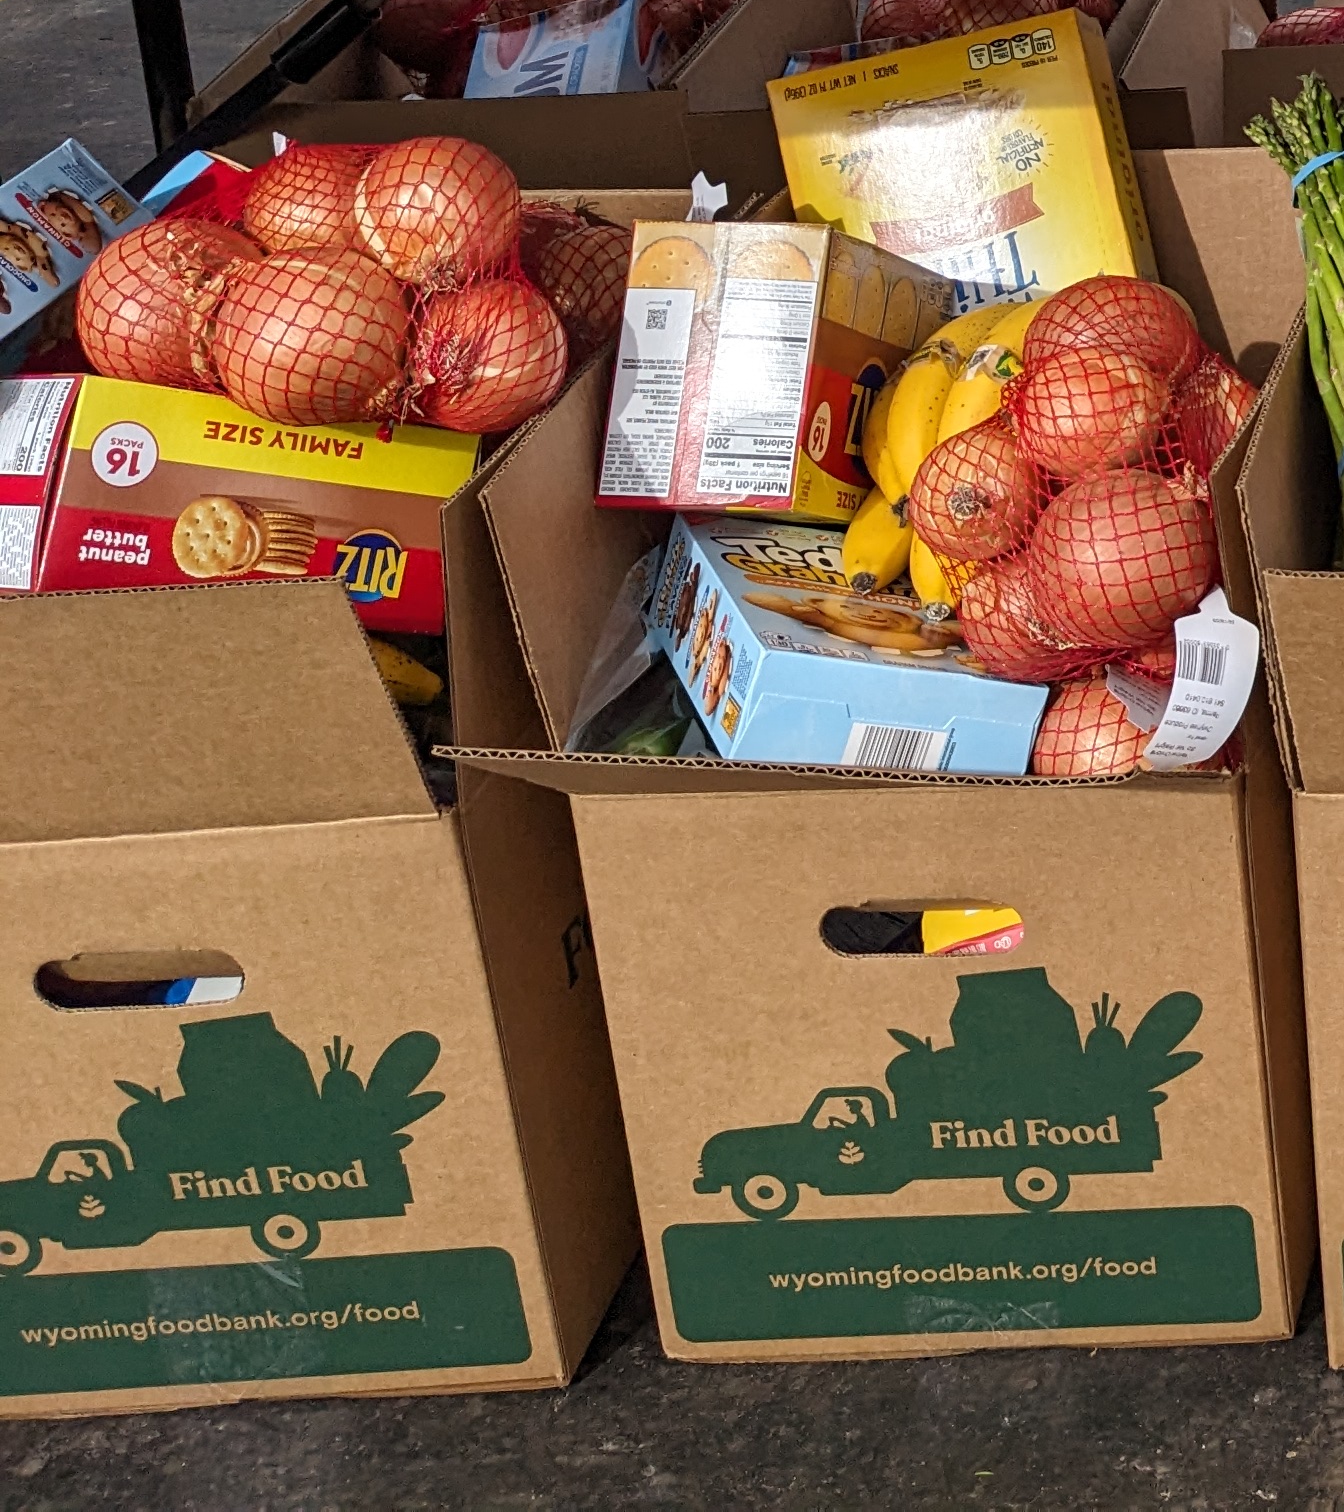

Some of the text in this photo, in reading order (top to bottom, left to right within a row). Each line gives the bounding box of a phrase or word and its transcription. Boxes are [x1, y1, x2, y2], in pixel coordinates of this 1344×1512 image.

[1036, 40, 1052, 52] 140
[829, 77, 841, 89] WT
[842, 73, 857, 86] NET
[872, 64, 899, 80] SNACKS
[996, 138, 1044, 166] ARTIFICIAL
[1014, 153, 1042, 173] NO
[27, 205, 71, 249] CINNAMON
[110, 437, 144, 449] PACKS
[203, 421, 363, 460] FAMILY SIZE
[706, 437, 793, 449] Calories 200
[812, 425, 824, 453] 16
[16, 445, 28, 472] 200
[37, 437, 51, 473] Facts
[104, 447, 143, 477] 16
[721, 460, 734, 468] pack
[768, 461, 790, 470] Serving
[700, 478, 787, 493] Nutrition Facts
[836, 491, 856, 508] SIZE
[82, 528, 148, 552] butter
[78, 543, 151, 567] peanut
[332, 544, 408, 599] RITZ
[930, 1116, 1120, 1149] Find Food
[168, 1160, 368, 1201] Find Food
[769, 1257, 1157, 1291] wyomingfoodbank.org/food
[21, 1301, 420, 1347] wyomingfoodbank.org/food
